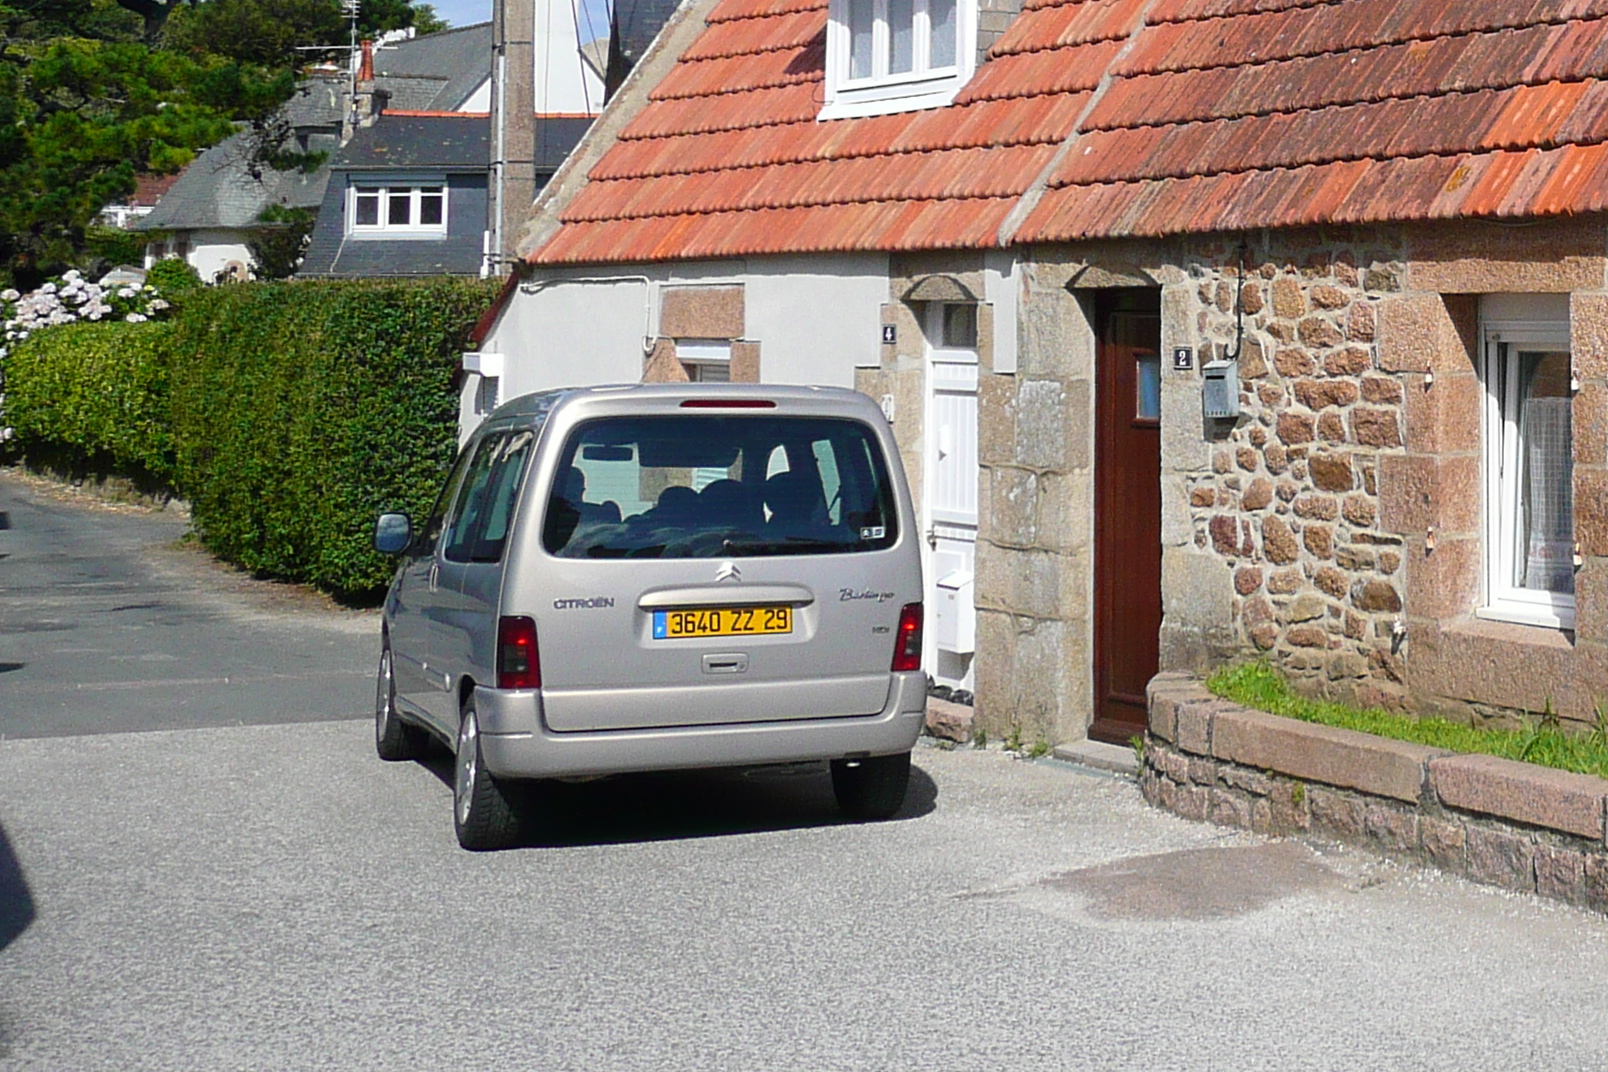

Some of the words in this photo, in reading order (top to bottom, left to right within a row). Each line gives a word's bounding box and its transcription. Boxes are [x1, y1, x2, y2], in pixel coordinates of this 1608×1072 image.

[885, 327, 893, 341] 4
[1179, 350, 1187, 366] 2
[671, 612, 721, 634] 3640
[731, 610, 754, 631] ZZ
[764, 609, 788, 630] 29
